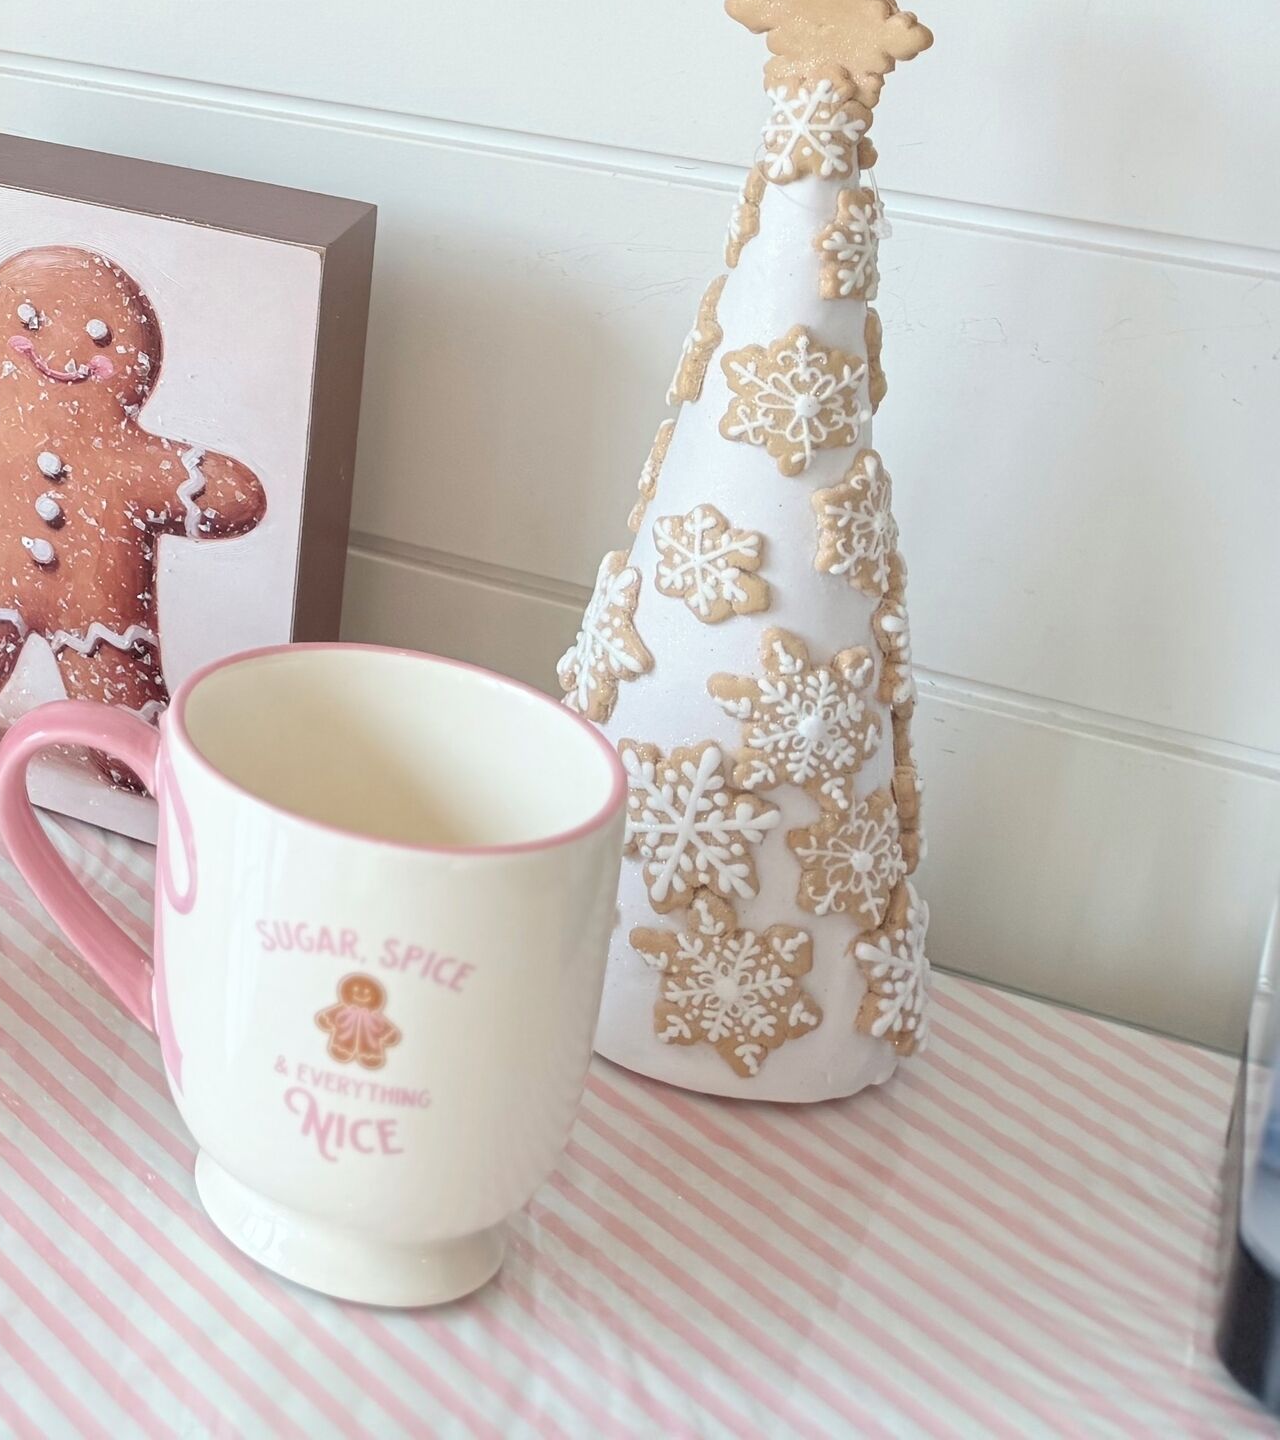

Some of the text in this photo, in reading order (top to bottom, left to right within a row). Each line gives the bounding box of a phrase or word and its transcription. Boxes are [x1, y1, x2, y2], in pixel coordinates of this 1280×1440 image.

[255, 919, 477, 993] SUGAR, SPICE
[273, 1054, 432, 1109] & EVERYTHING
[283, 1086, 404, 1162] NICE
